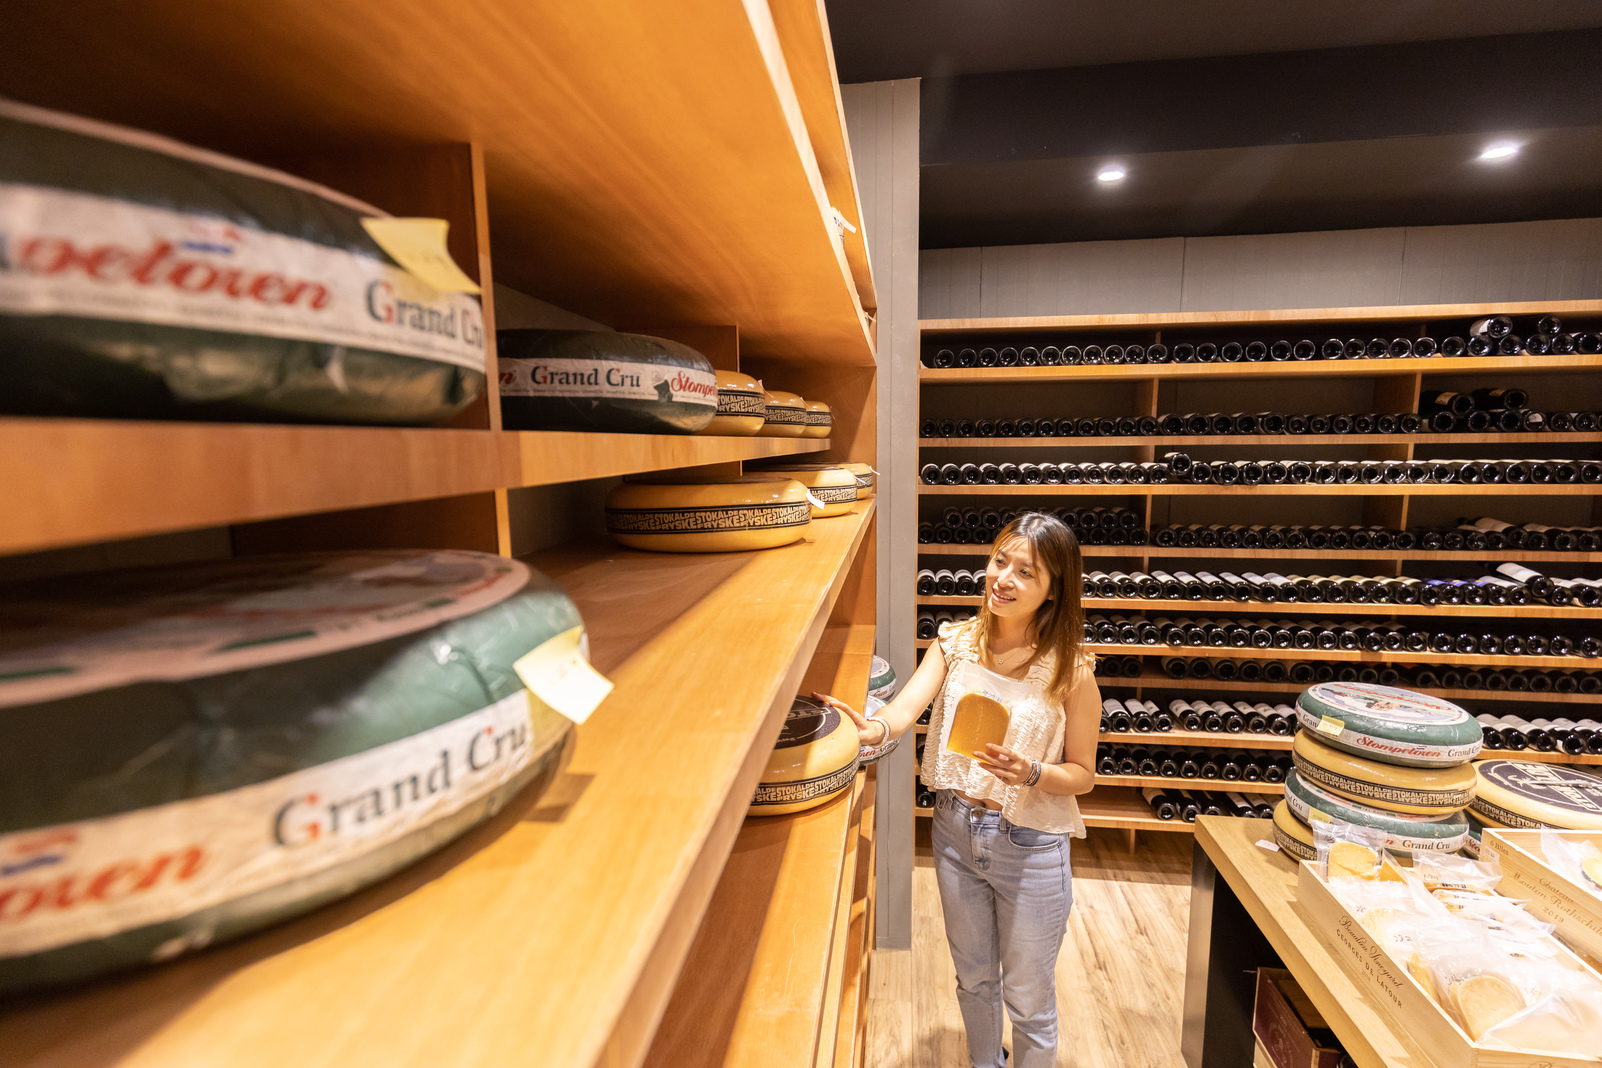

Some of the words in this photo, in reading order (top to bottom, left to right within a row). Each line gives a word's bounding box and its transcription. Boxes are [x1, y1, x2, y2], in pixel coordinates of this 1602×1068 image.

[366, 279, 456, 340] Grand
[531, 365, 600, 386] Grand
[606, 367, 641, 388] Cru
[654, 512, 695, 525] STOKALDE
[695, 510, 739, 524] STOKALDE
[656, 518, 697, 530] FRYSKE
[699, 515, 740, 529] FRYSKE
[1356, 736, 1441, 757] Stompetoren
[274, 749, 452, 846] Grand
[467, 726, 527, 772] Cru
[776, 782, 815, 797] STOKALDE
[777, 787, 815, 801] FRYSKE
[1356, 781, 1391, 794] STOKALDE
[1392, 789, 1428, 798] STOKALDE
[1402, 839, 1434, 850] Grand
[1436, 841, 1451, 850] Cru
[1509, 872, 1547, 899] Mouton
[1543, 906, 1566, 923] 2019
[1338, 915, 1369, 952] Beaulieu
[1369, 945, 1404, 989] Vineyard
[1336, 928, 1363, 963] GEORGES
[1365, 962, 1374, 976] DE
[1377, 975, 1402, 1009] LATOUR
